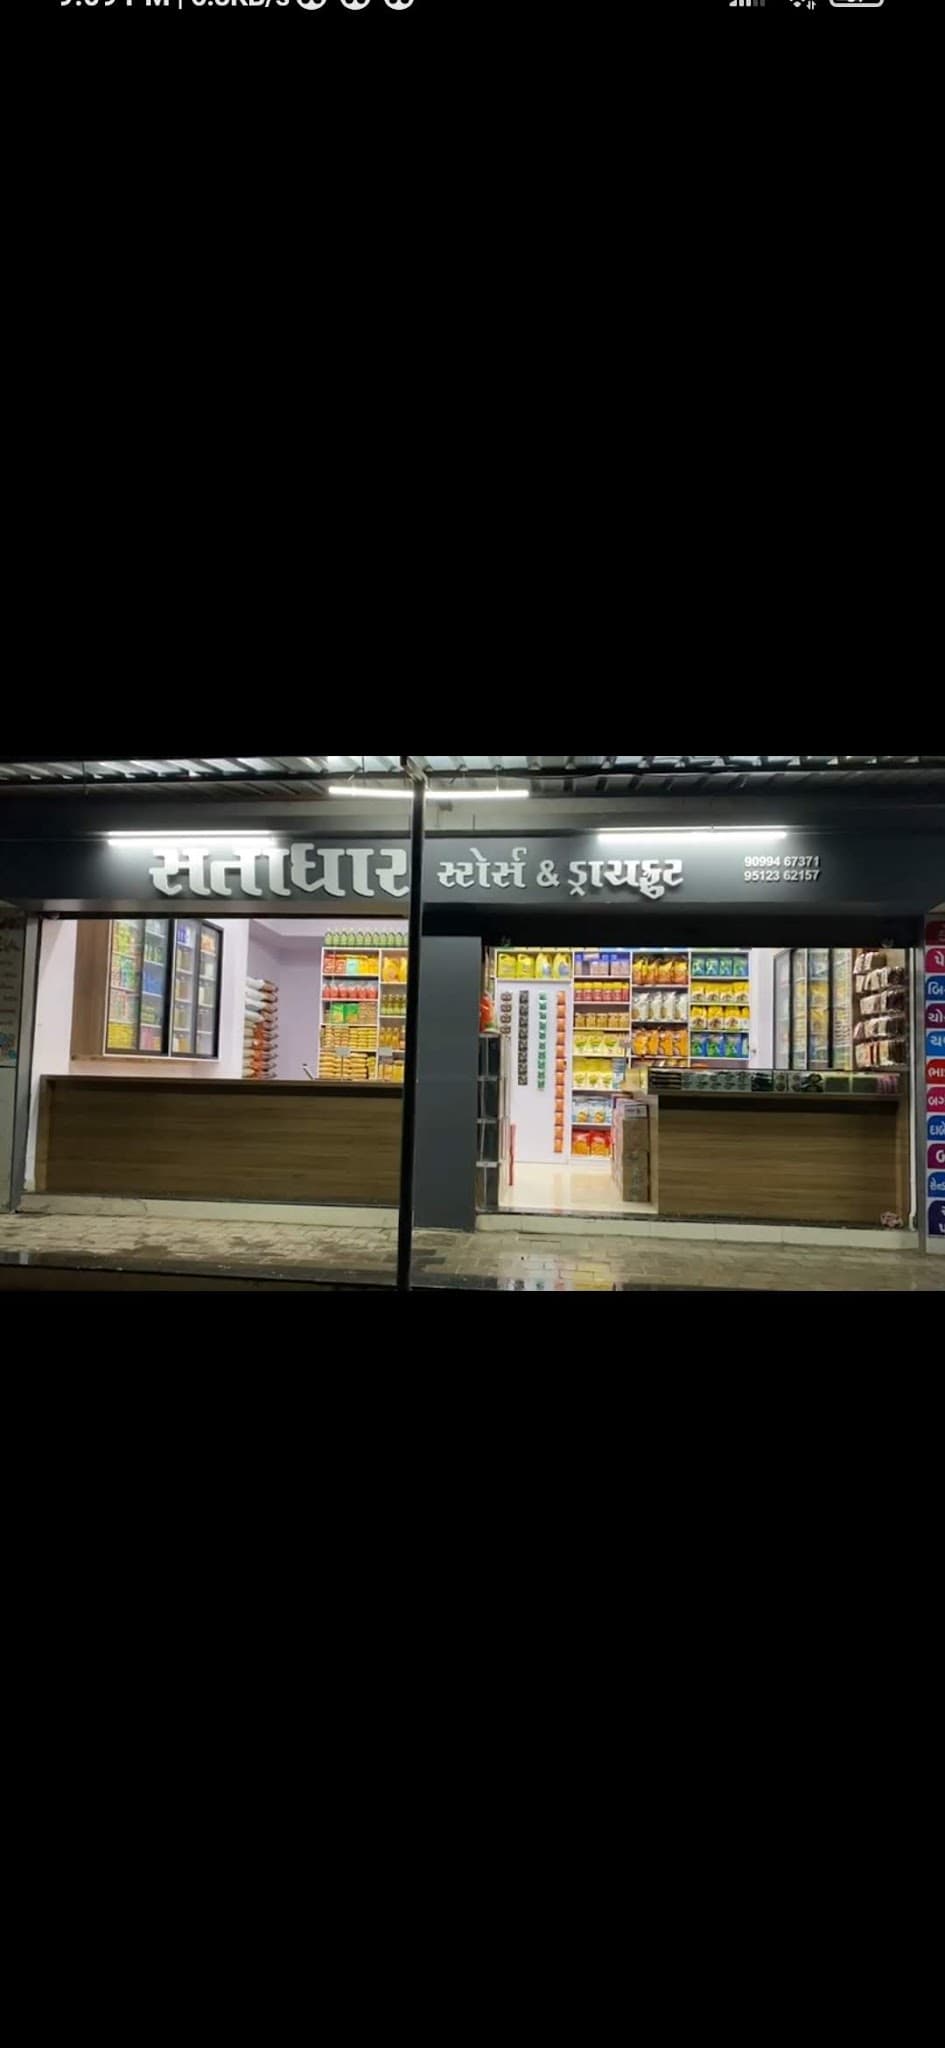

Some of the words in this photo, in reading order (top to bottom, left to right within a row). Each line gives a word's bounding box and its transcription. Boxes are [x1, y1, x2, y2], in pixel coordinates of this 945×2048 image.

[744, 855, 780, 867] 90994
[783, 855, 820, 867] 67371
[149, 843, 410, 896] સતાધાર
[437, 847, 528, 888] સ્ટોર્સ
[536, 860, 560, 888] &
[743, 870, 780, 881] 95123
[783, 869, 821, 881] 62157
